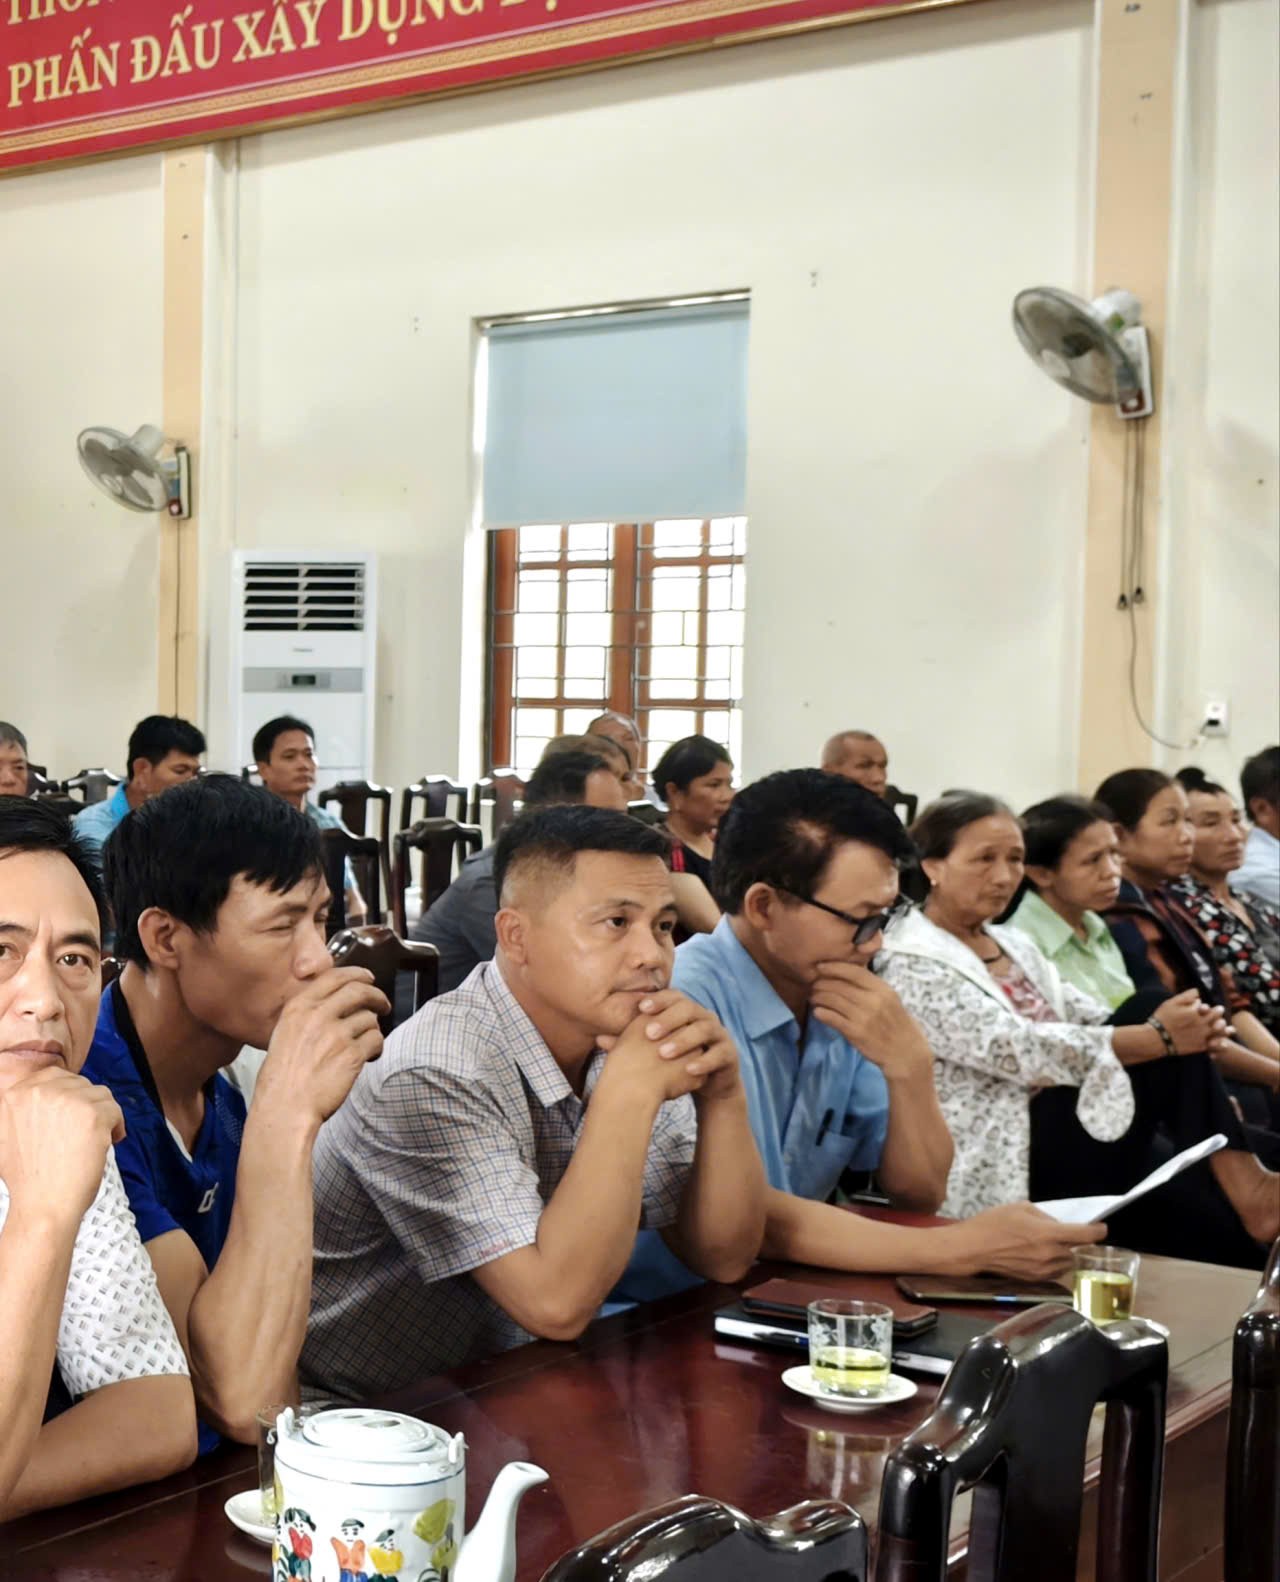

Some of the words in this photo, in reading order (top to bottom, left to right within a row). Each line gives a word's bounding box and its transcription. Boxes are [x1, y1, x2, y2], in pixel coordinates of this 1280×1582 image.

[7, 27, 121, 108] PHẤN
[130, 9, 224, 84] ĐẤU
[231, 0, 326, 63] XÂY
